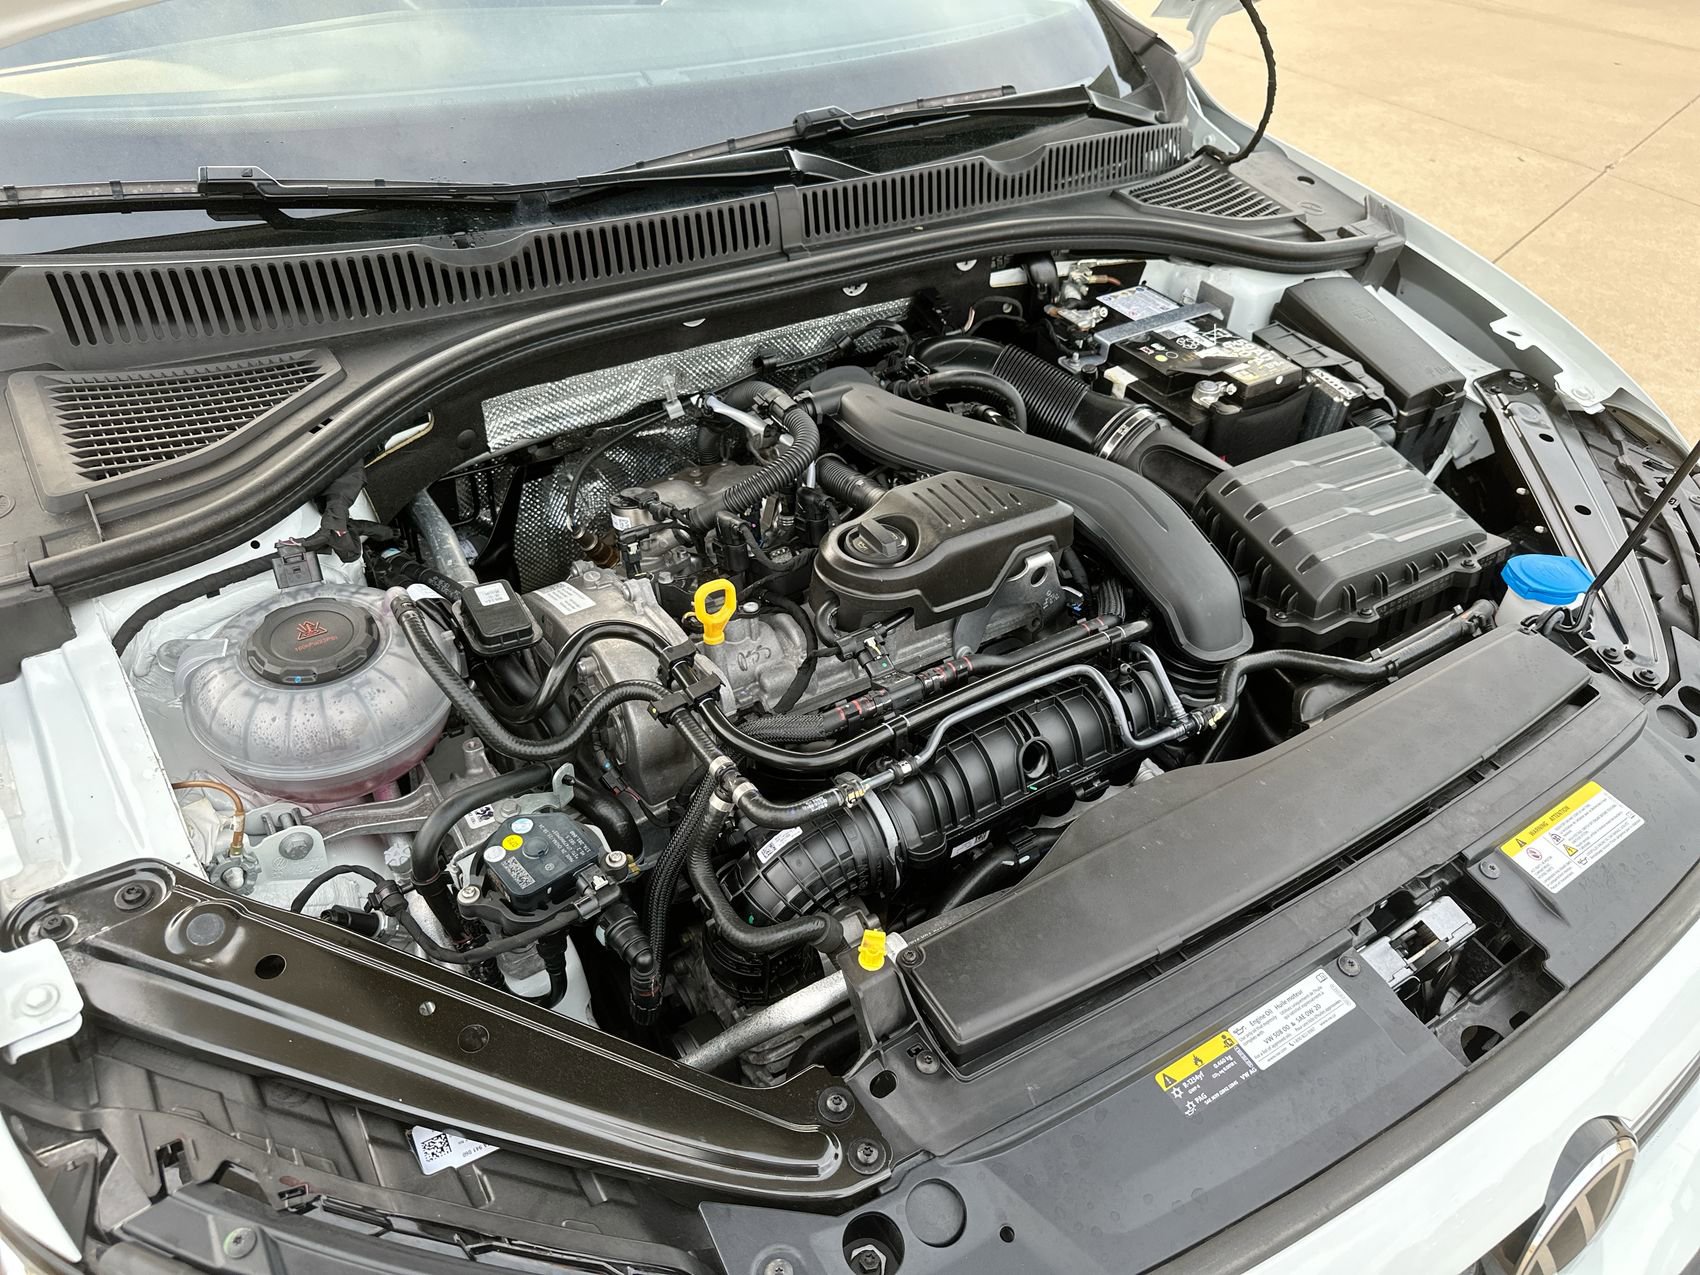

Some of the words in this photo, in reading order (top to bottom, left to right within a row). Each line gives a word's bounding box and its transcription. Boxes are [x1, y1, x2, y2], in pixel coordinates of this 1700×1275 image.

[1529, 821, 1549, 836] WARNING
[1549, 806, 1570, 822] ATTENTION
[1274, 1000, 1287, 1010] Huile
[1286, 989, 1303, 1002] moteur
[1249, 1014, 1266, 1027] Engine
[1263, 1035, 1274, 1044] VW
[1272, 1029, 1283, 1038] 508
[1282, 1024, 1291, 1032] 00
[1295, 1014, 1306, 1023] SAE
[1304, 1008, 1314, 1017] 0W
[1313, 1003, 1321, 1011] 20
[1182, 1070, 1205, 1089] R-1234yf
[1239, 1071, 1250, 1080] VW
[1249, 1067, 1257, 1075] AG
[1194, 1092, 1207, 1104] PAG
